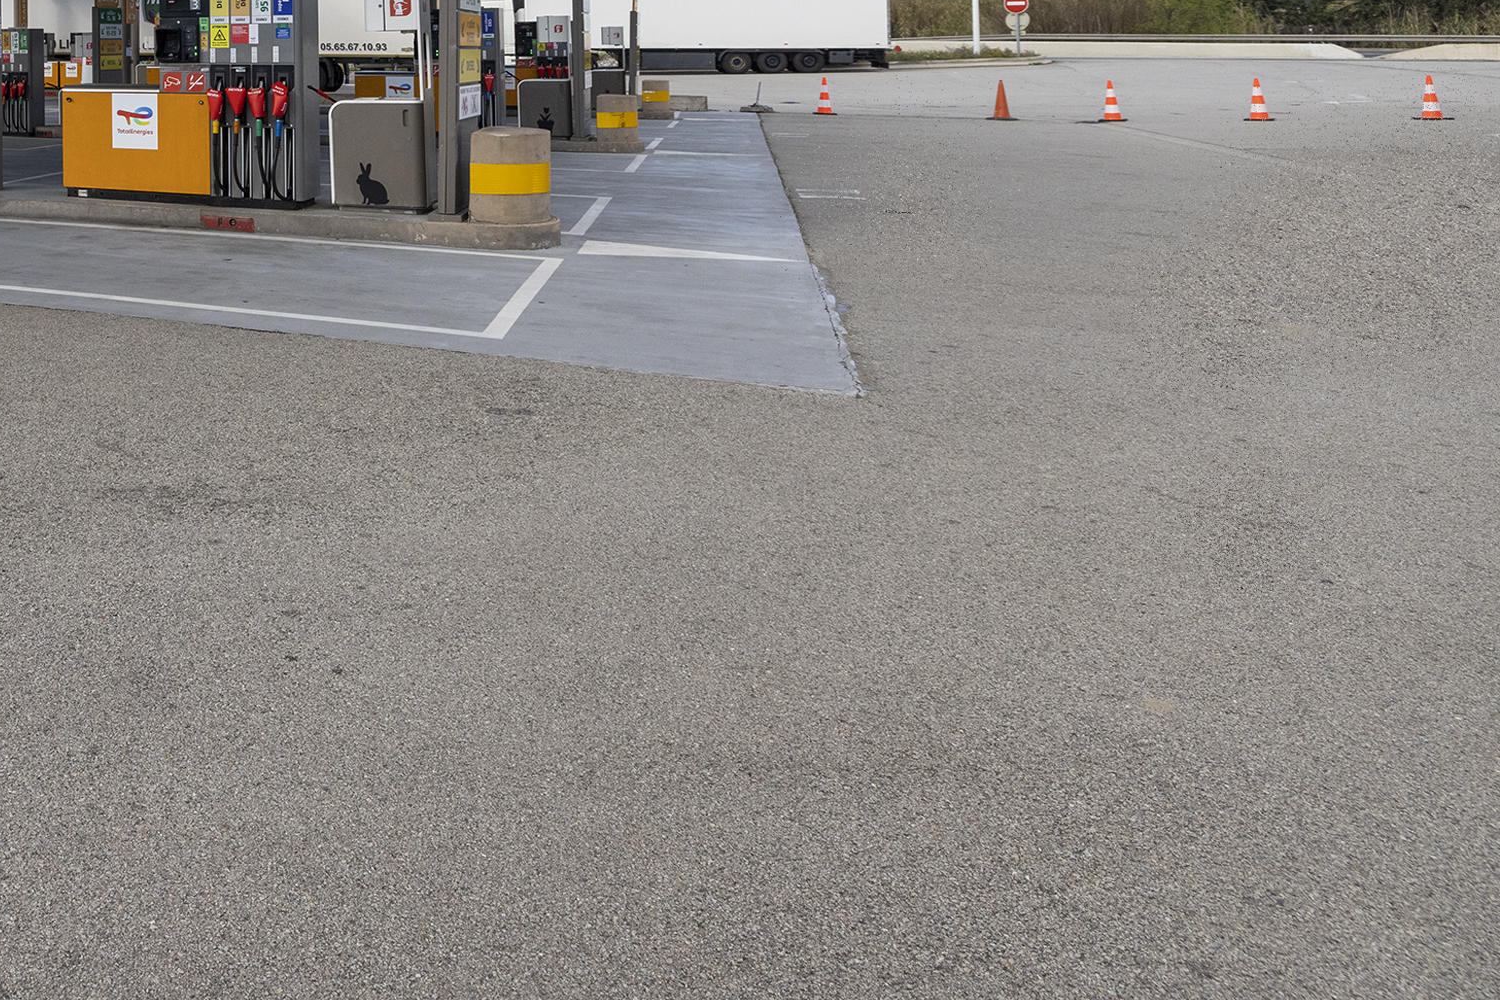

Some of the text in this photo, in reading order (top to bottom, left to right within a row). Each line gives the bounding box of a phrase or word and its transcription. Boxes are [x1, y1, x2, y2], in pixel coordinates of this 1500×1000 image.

[192, 0, 199, 10] 3
[320, 42, 388, 51] 05.65.67.10.93
[117, 128, 154, 136] TotalEnergies
